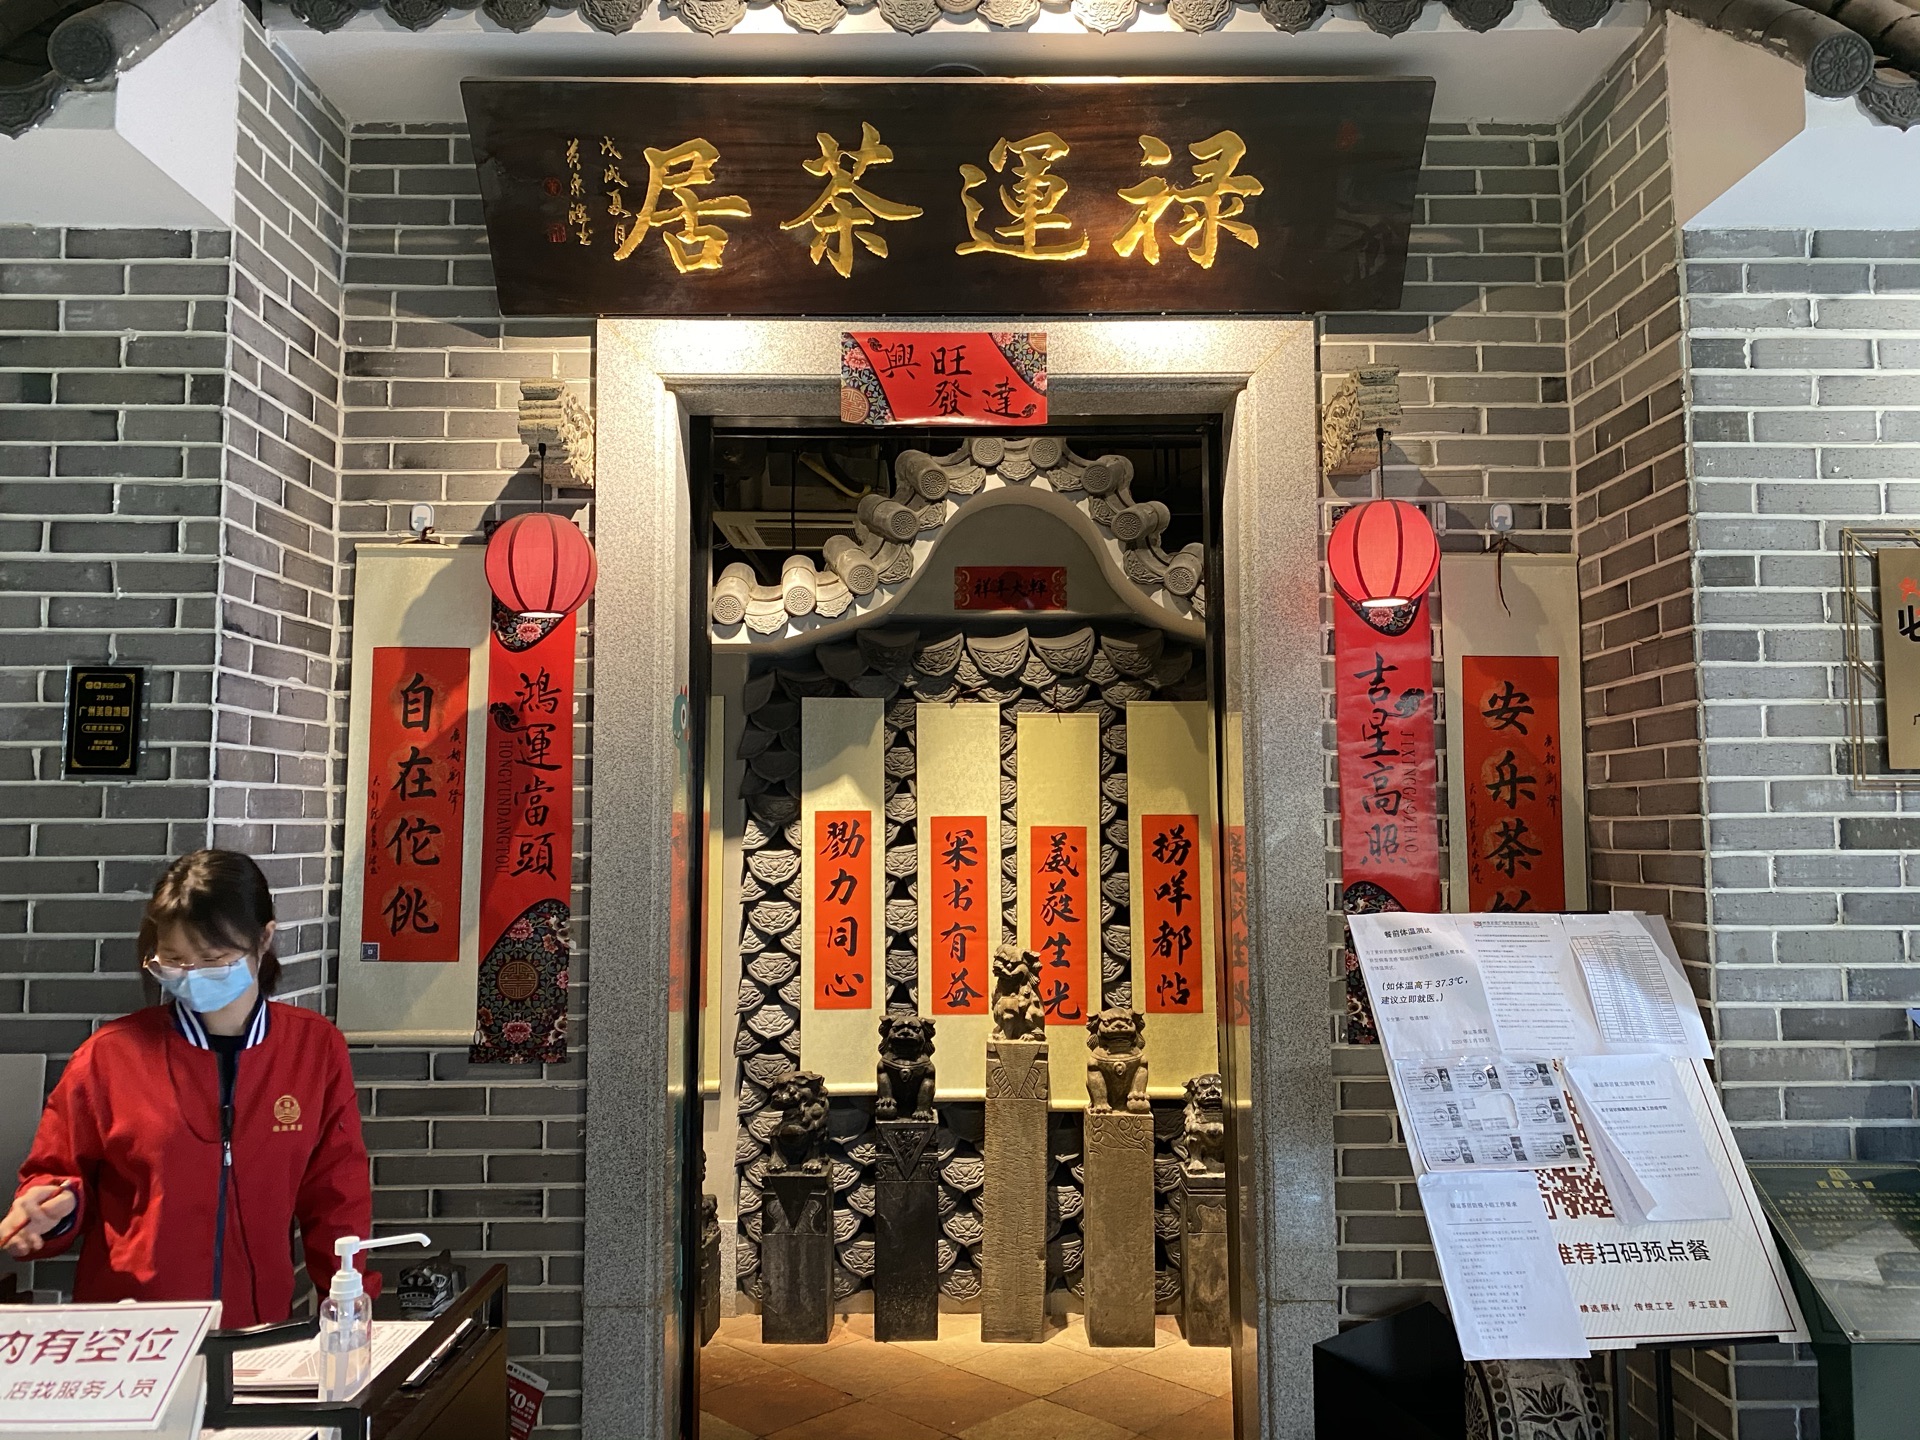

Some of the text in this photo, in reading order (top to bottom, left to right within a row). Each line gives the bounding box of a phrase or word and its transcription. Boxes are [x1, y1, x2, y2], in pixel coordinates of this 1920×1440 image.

[494, 740, 514, 874] HONGYUNDANGTOU
[1353, 651, 1408, 865] 吉星高照
